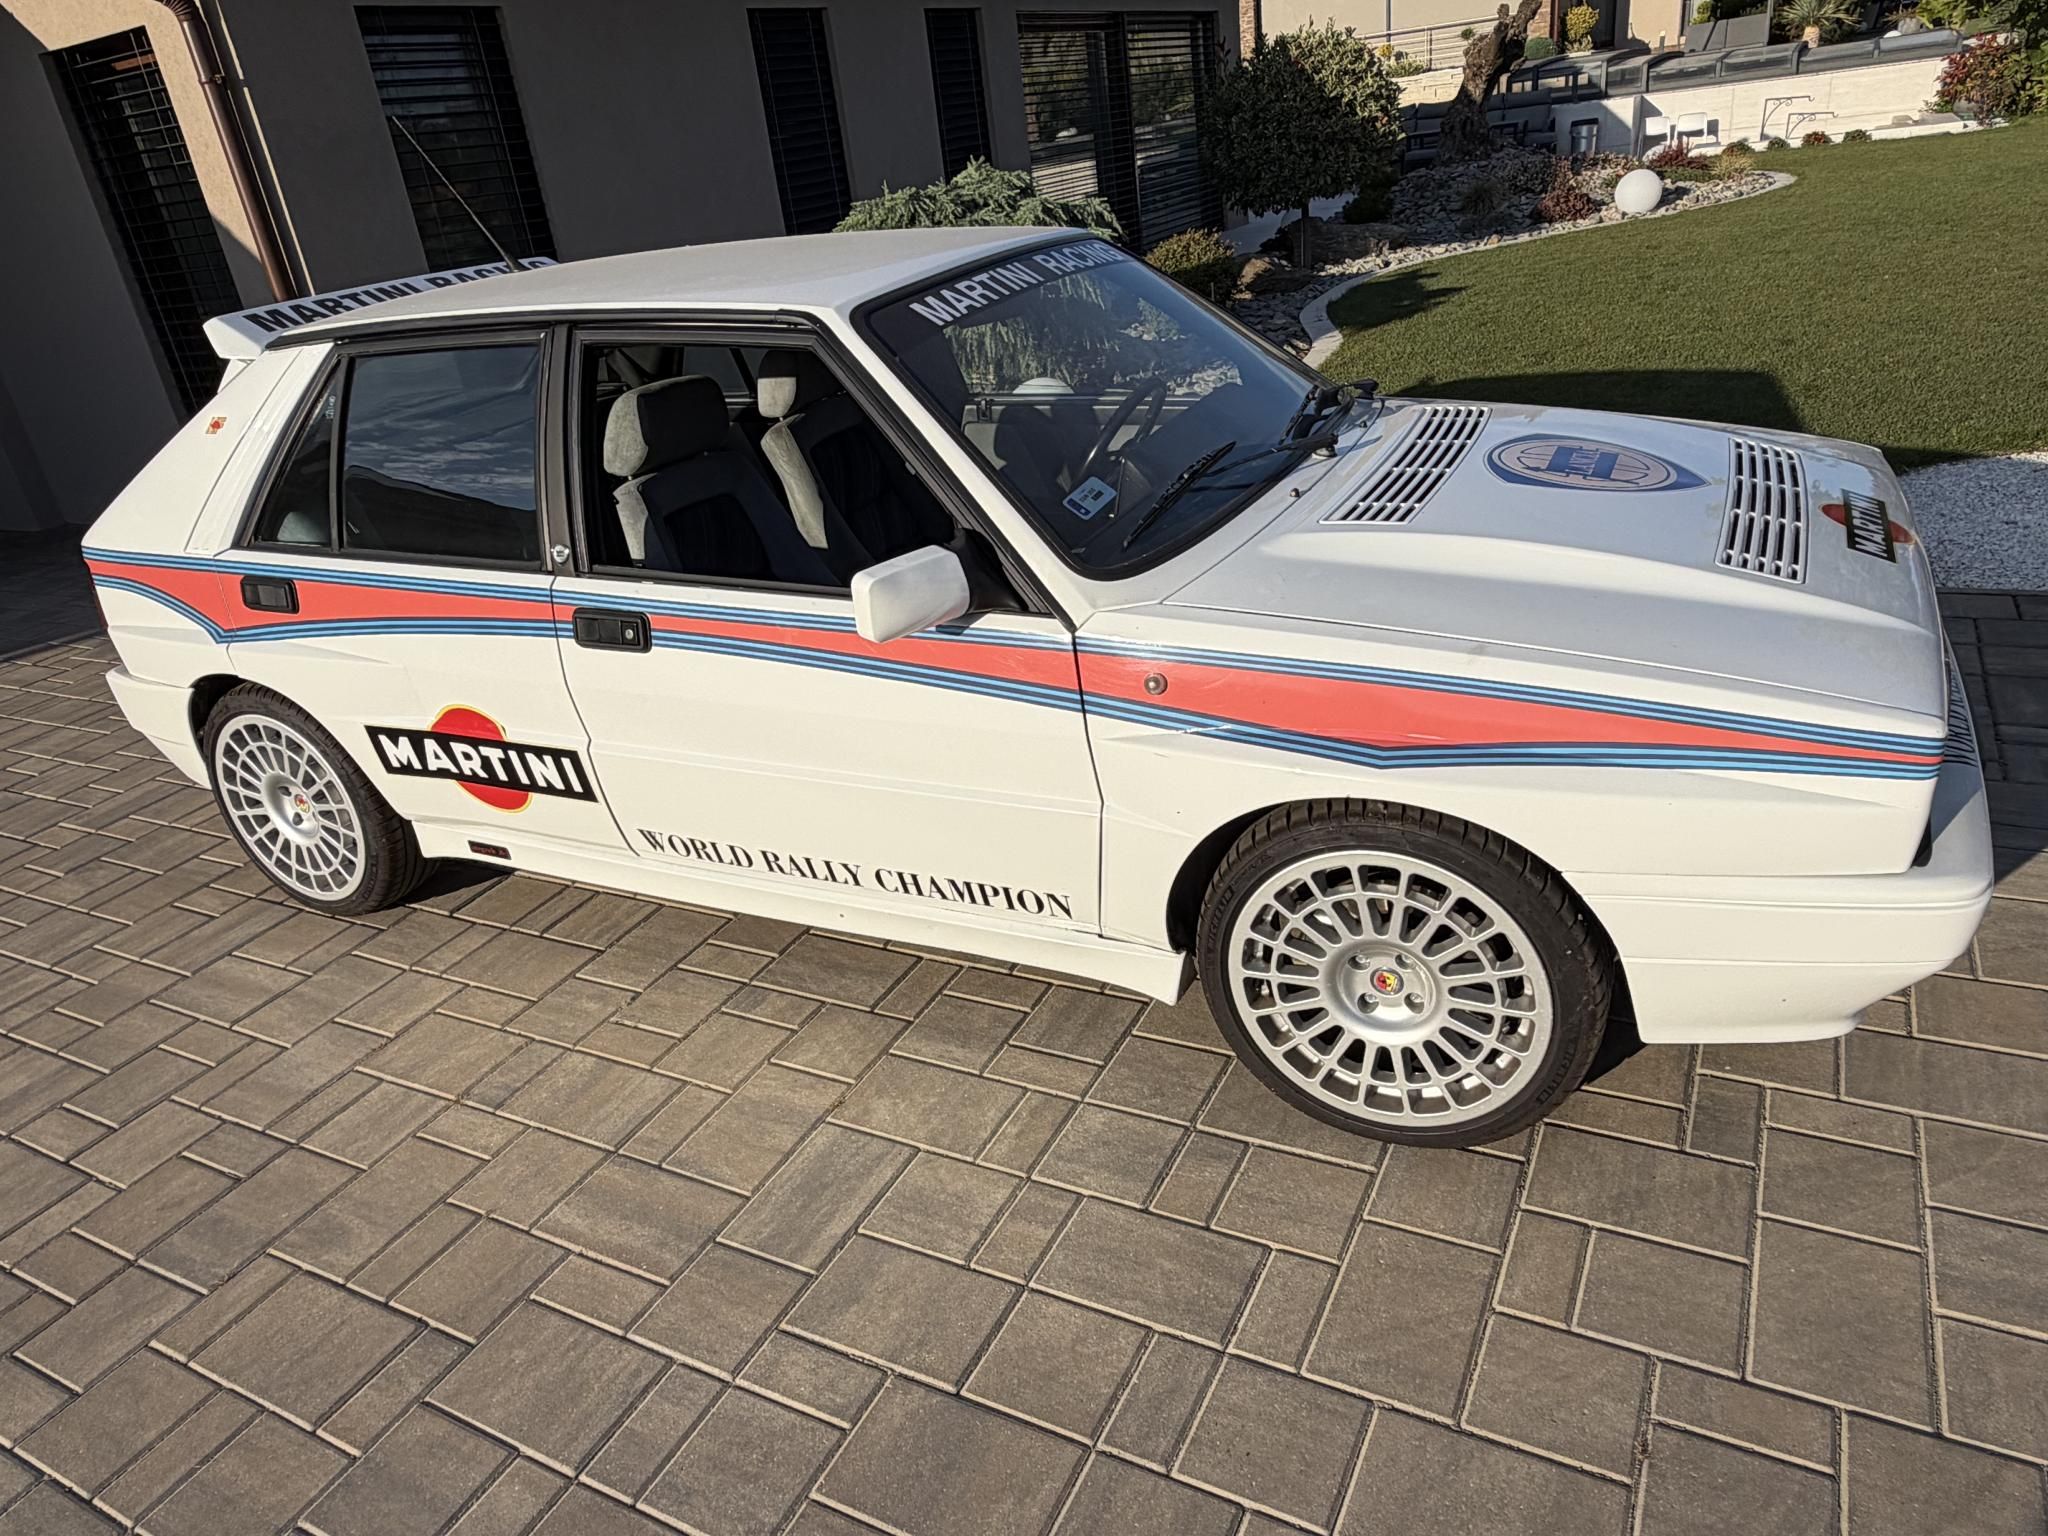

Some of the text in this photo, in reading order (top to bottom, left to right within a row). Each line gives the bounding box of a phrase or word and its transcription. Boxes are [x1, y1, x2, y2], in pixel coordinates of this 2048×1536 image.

[909, 243, 1124, 326] MARTINI RACING
[1848, 492, 1888, 558] MARTINI
[377, 734, 583, 793] MARTINI
[637, 828, 1074, 920] WORLD RALLY CHAMPION
